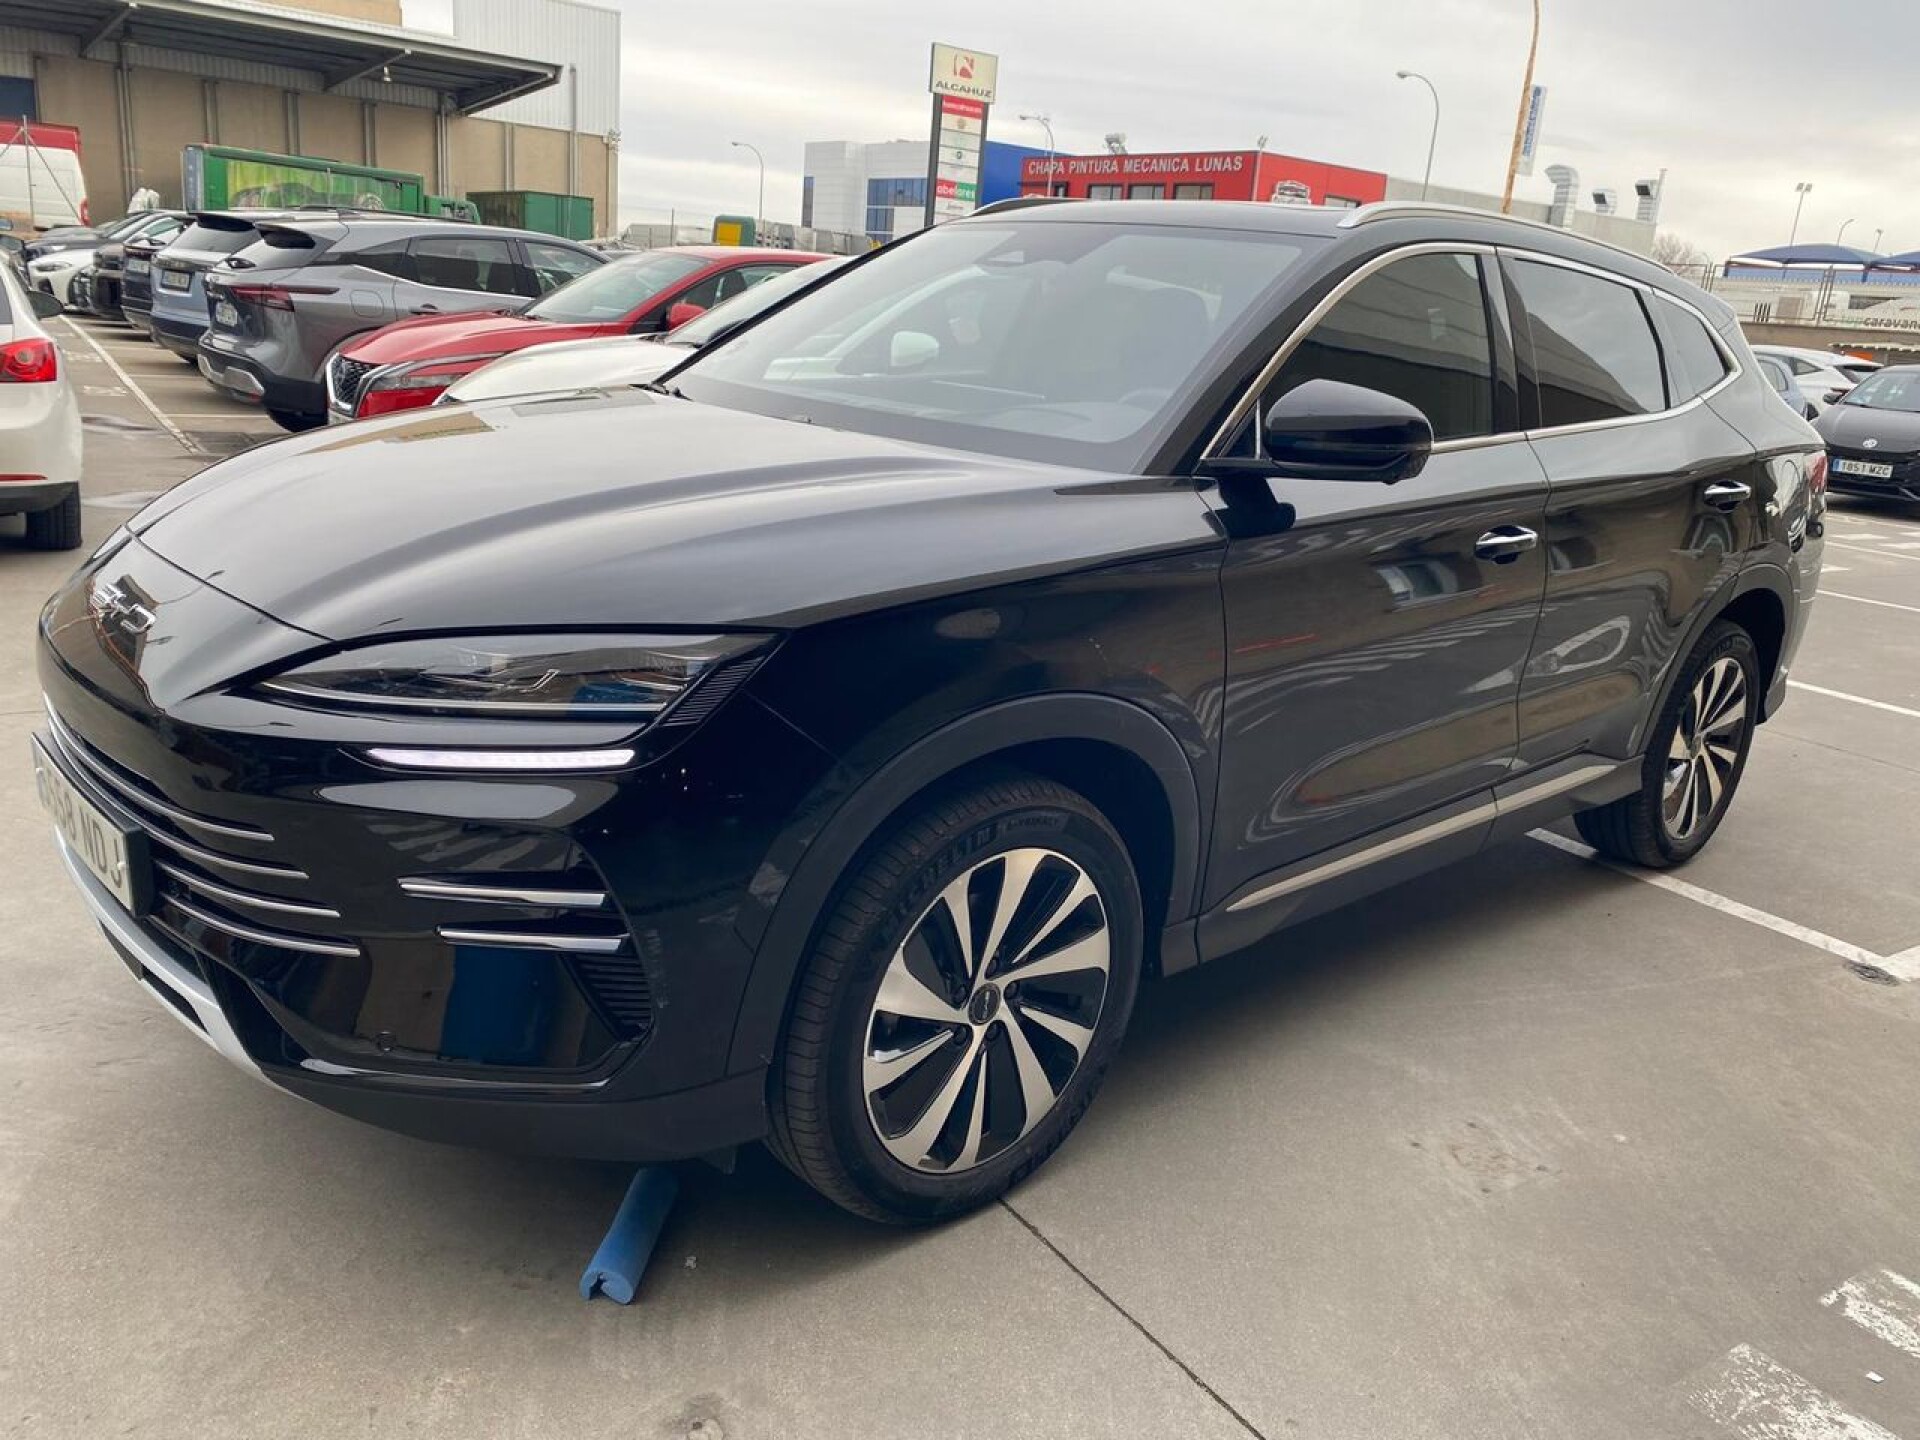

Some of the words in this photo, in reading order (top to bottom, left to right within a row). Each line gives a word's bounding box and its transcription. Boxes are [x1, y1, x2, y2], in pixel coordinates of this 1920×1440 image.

[936, 80, 992, 97] ALCAHUZ
[1028, 161, 1065, 175] CHAPA
[1068, 160, 1118, 174] PINTURA
[1123, 158, 1189, 174] MECANICA
[1195, 155, 1243, 171] LUNAS
[1863, 317, 1920, 330] caravan
